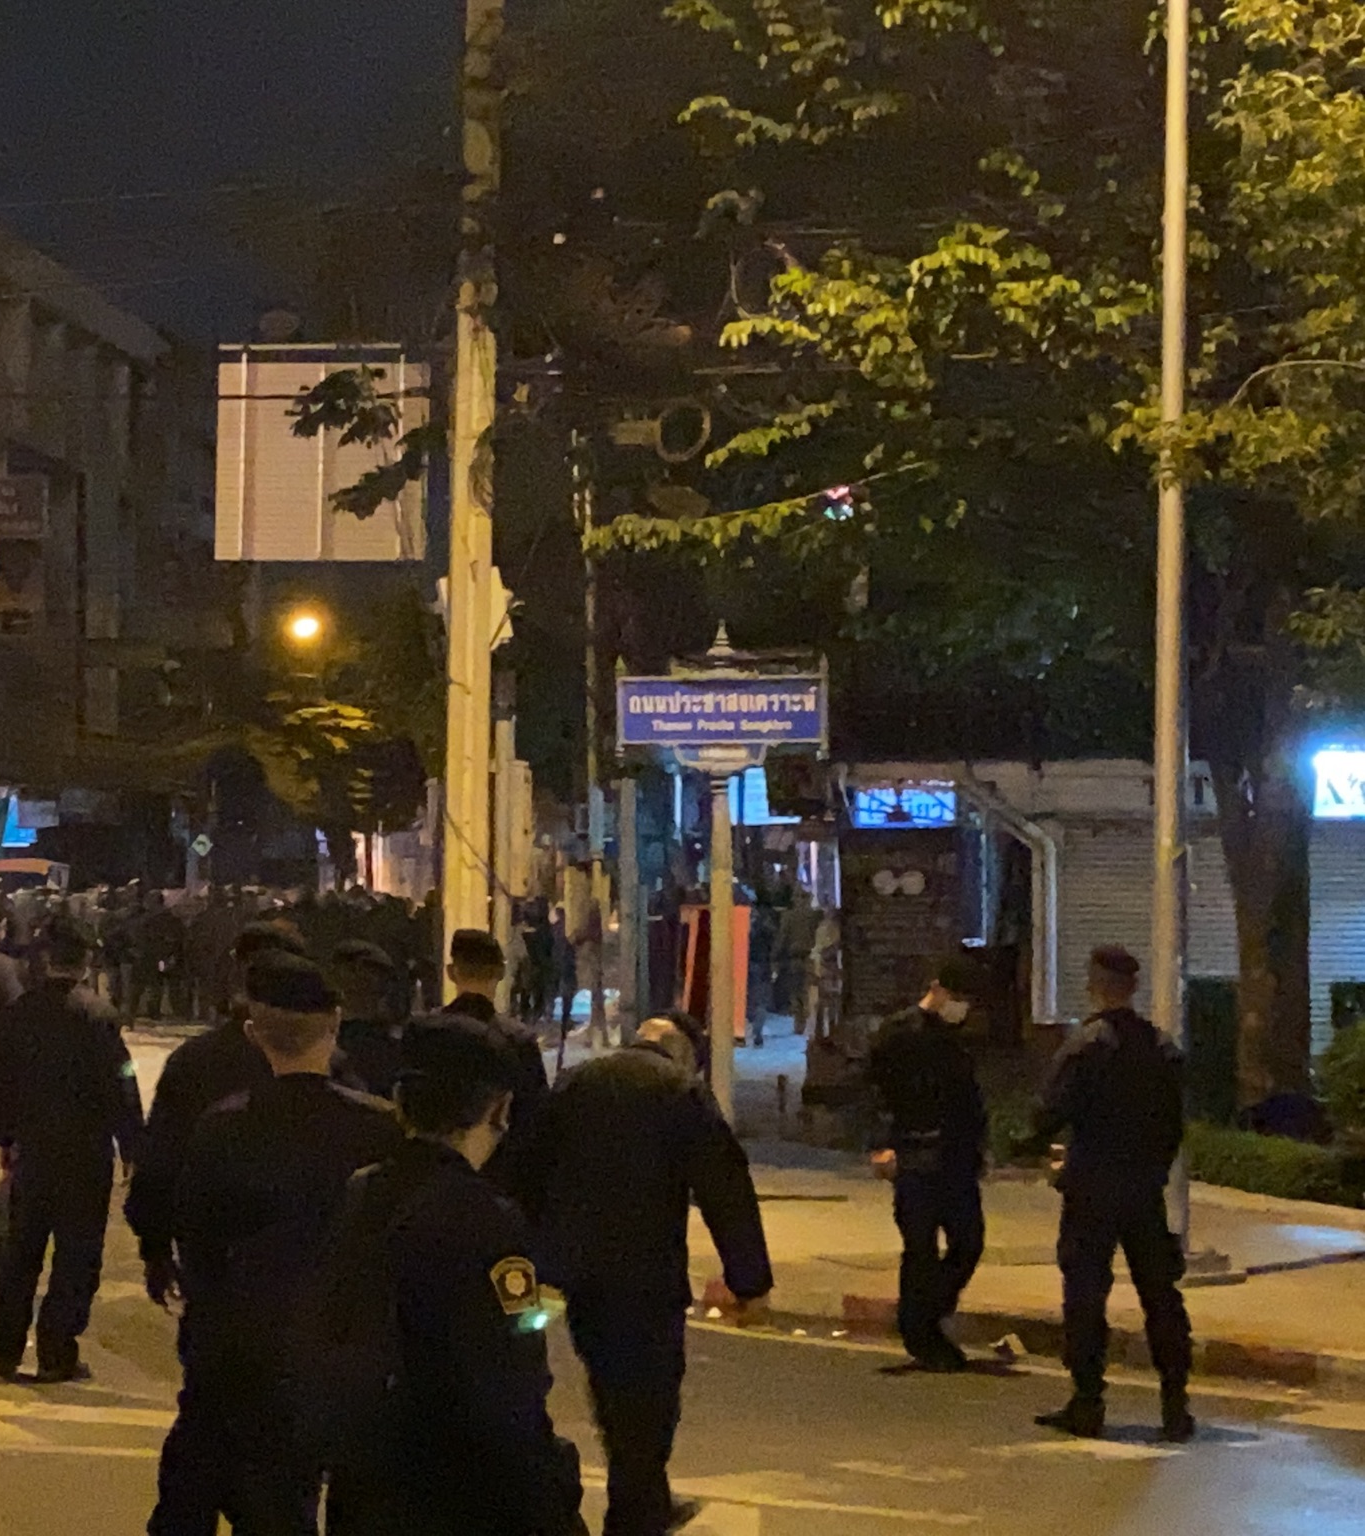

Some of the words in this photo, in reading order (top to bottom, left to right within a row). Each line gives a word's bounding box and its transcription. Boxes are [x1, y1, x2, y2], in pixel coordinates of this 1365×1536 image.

[628, 686, 818, 714] ถนนประชาสงเคราะห์
